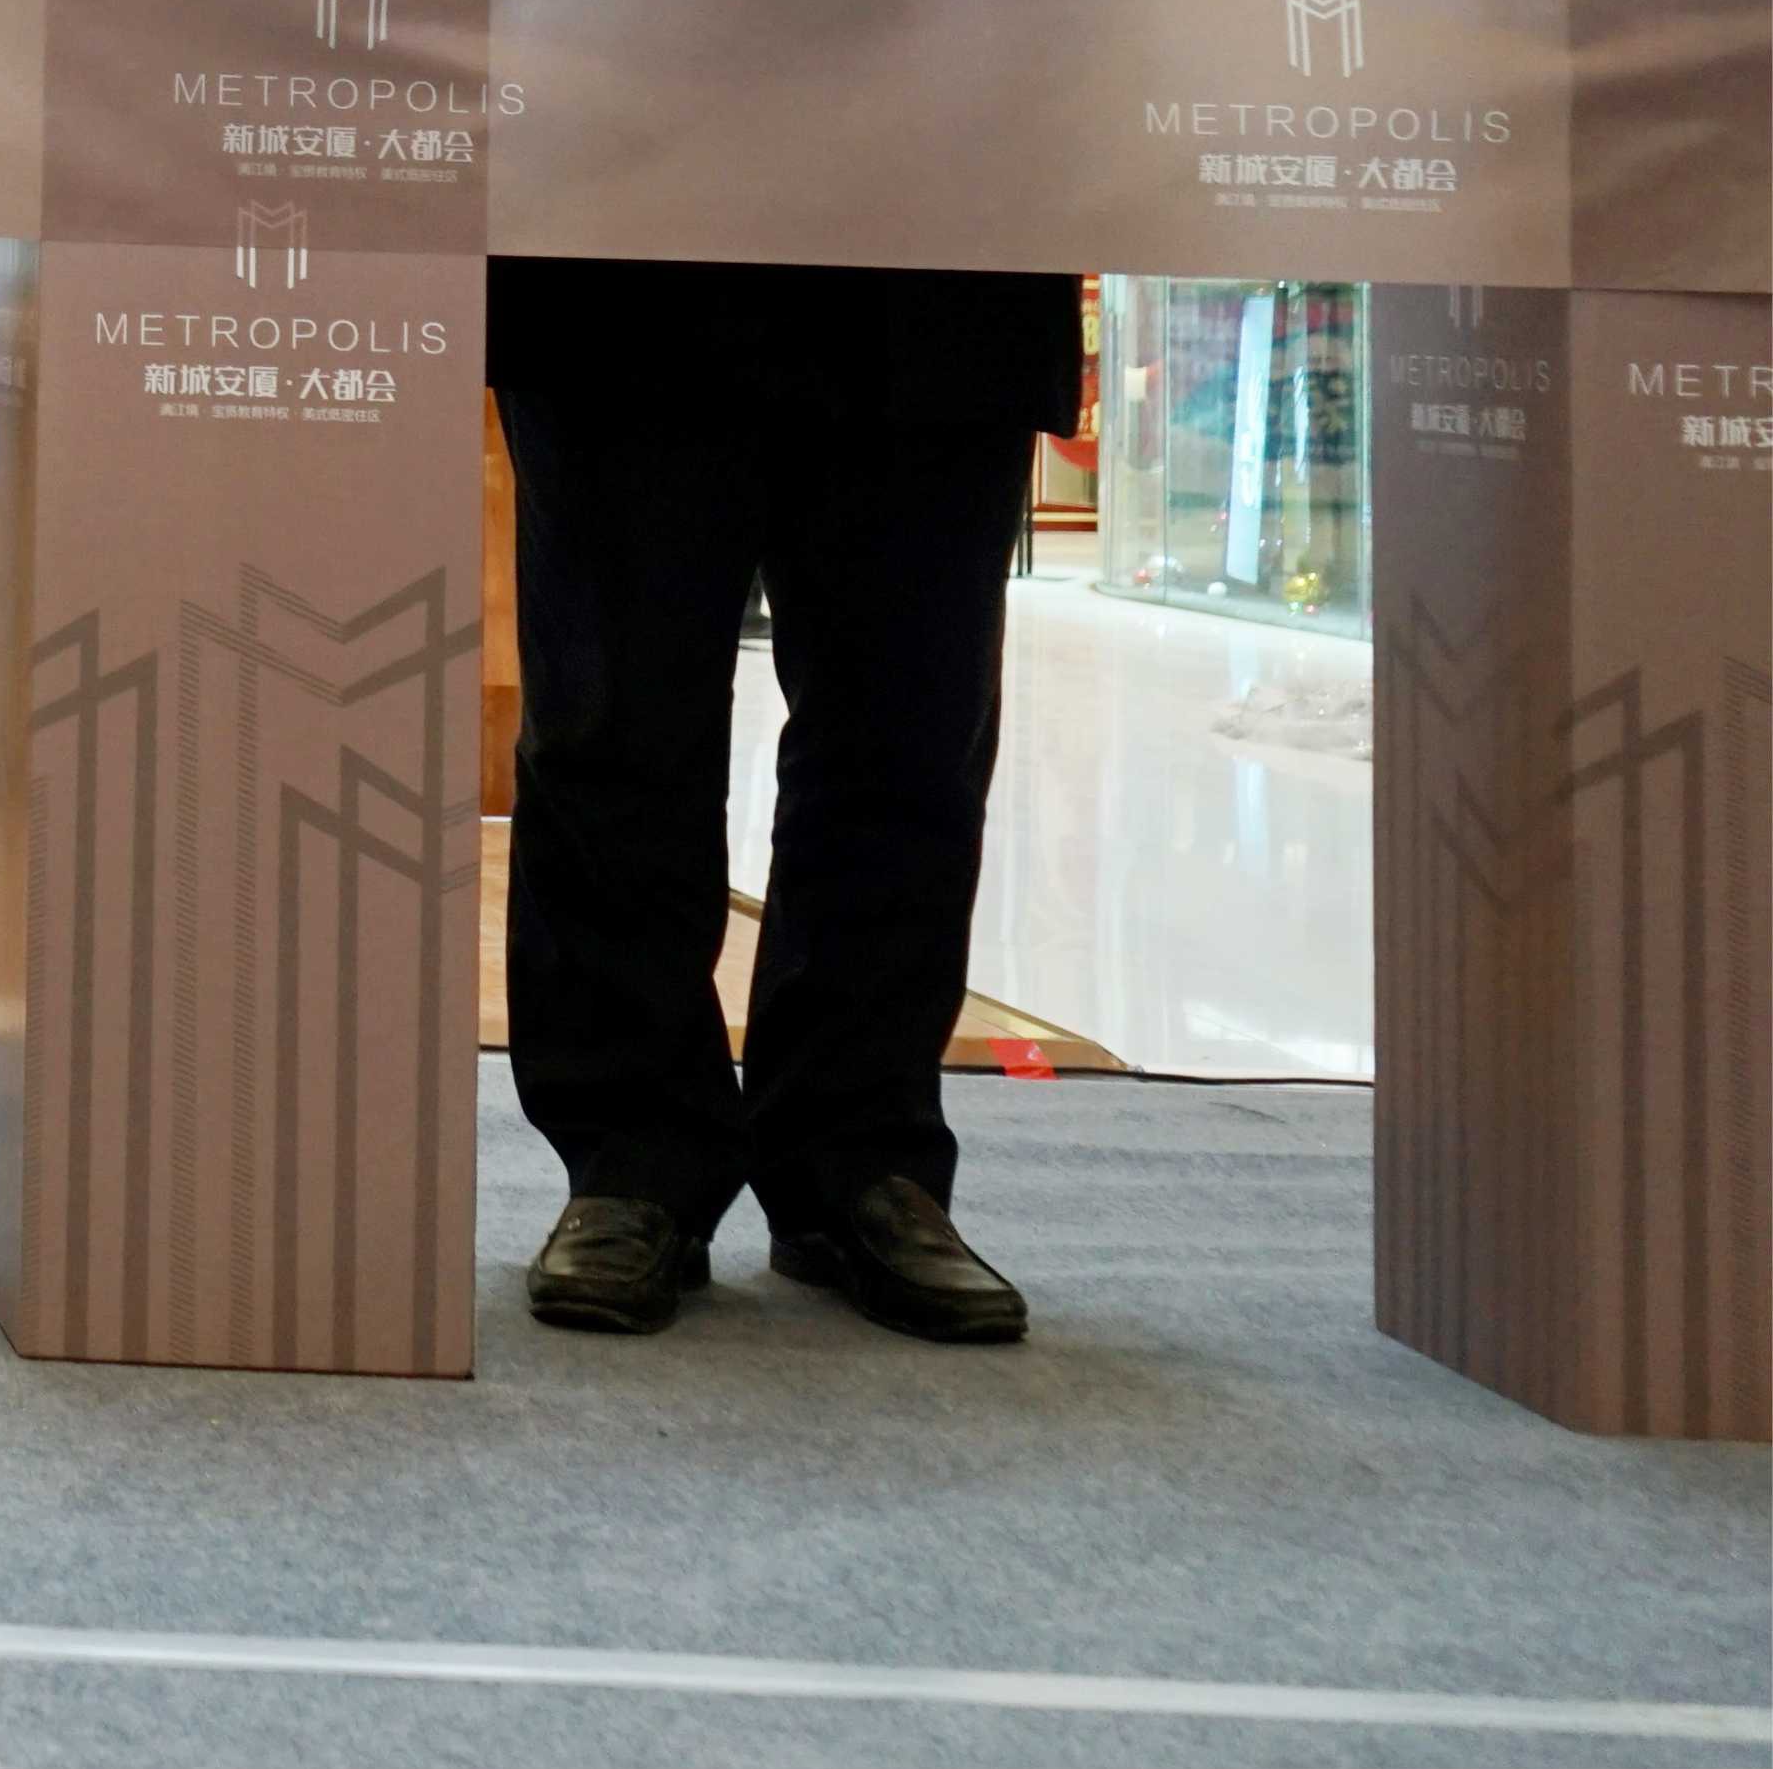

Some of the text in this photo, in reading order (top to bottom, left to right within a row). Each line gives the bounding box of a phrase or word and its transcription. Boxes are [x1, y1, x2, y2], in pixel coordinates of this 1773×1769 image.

[173, 72, 527, 117] METROPOLIS
[222, 122, 475, 165] 新城安厦·大都会
[1144, 102, 1511, 143] METROPOLIS
[94, 311, 448, 354] METROPOLIS
[143, 362, 398, 404] 新城安厦·大都会
